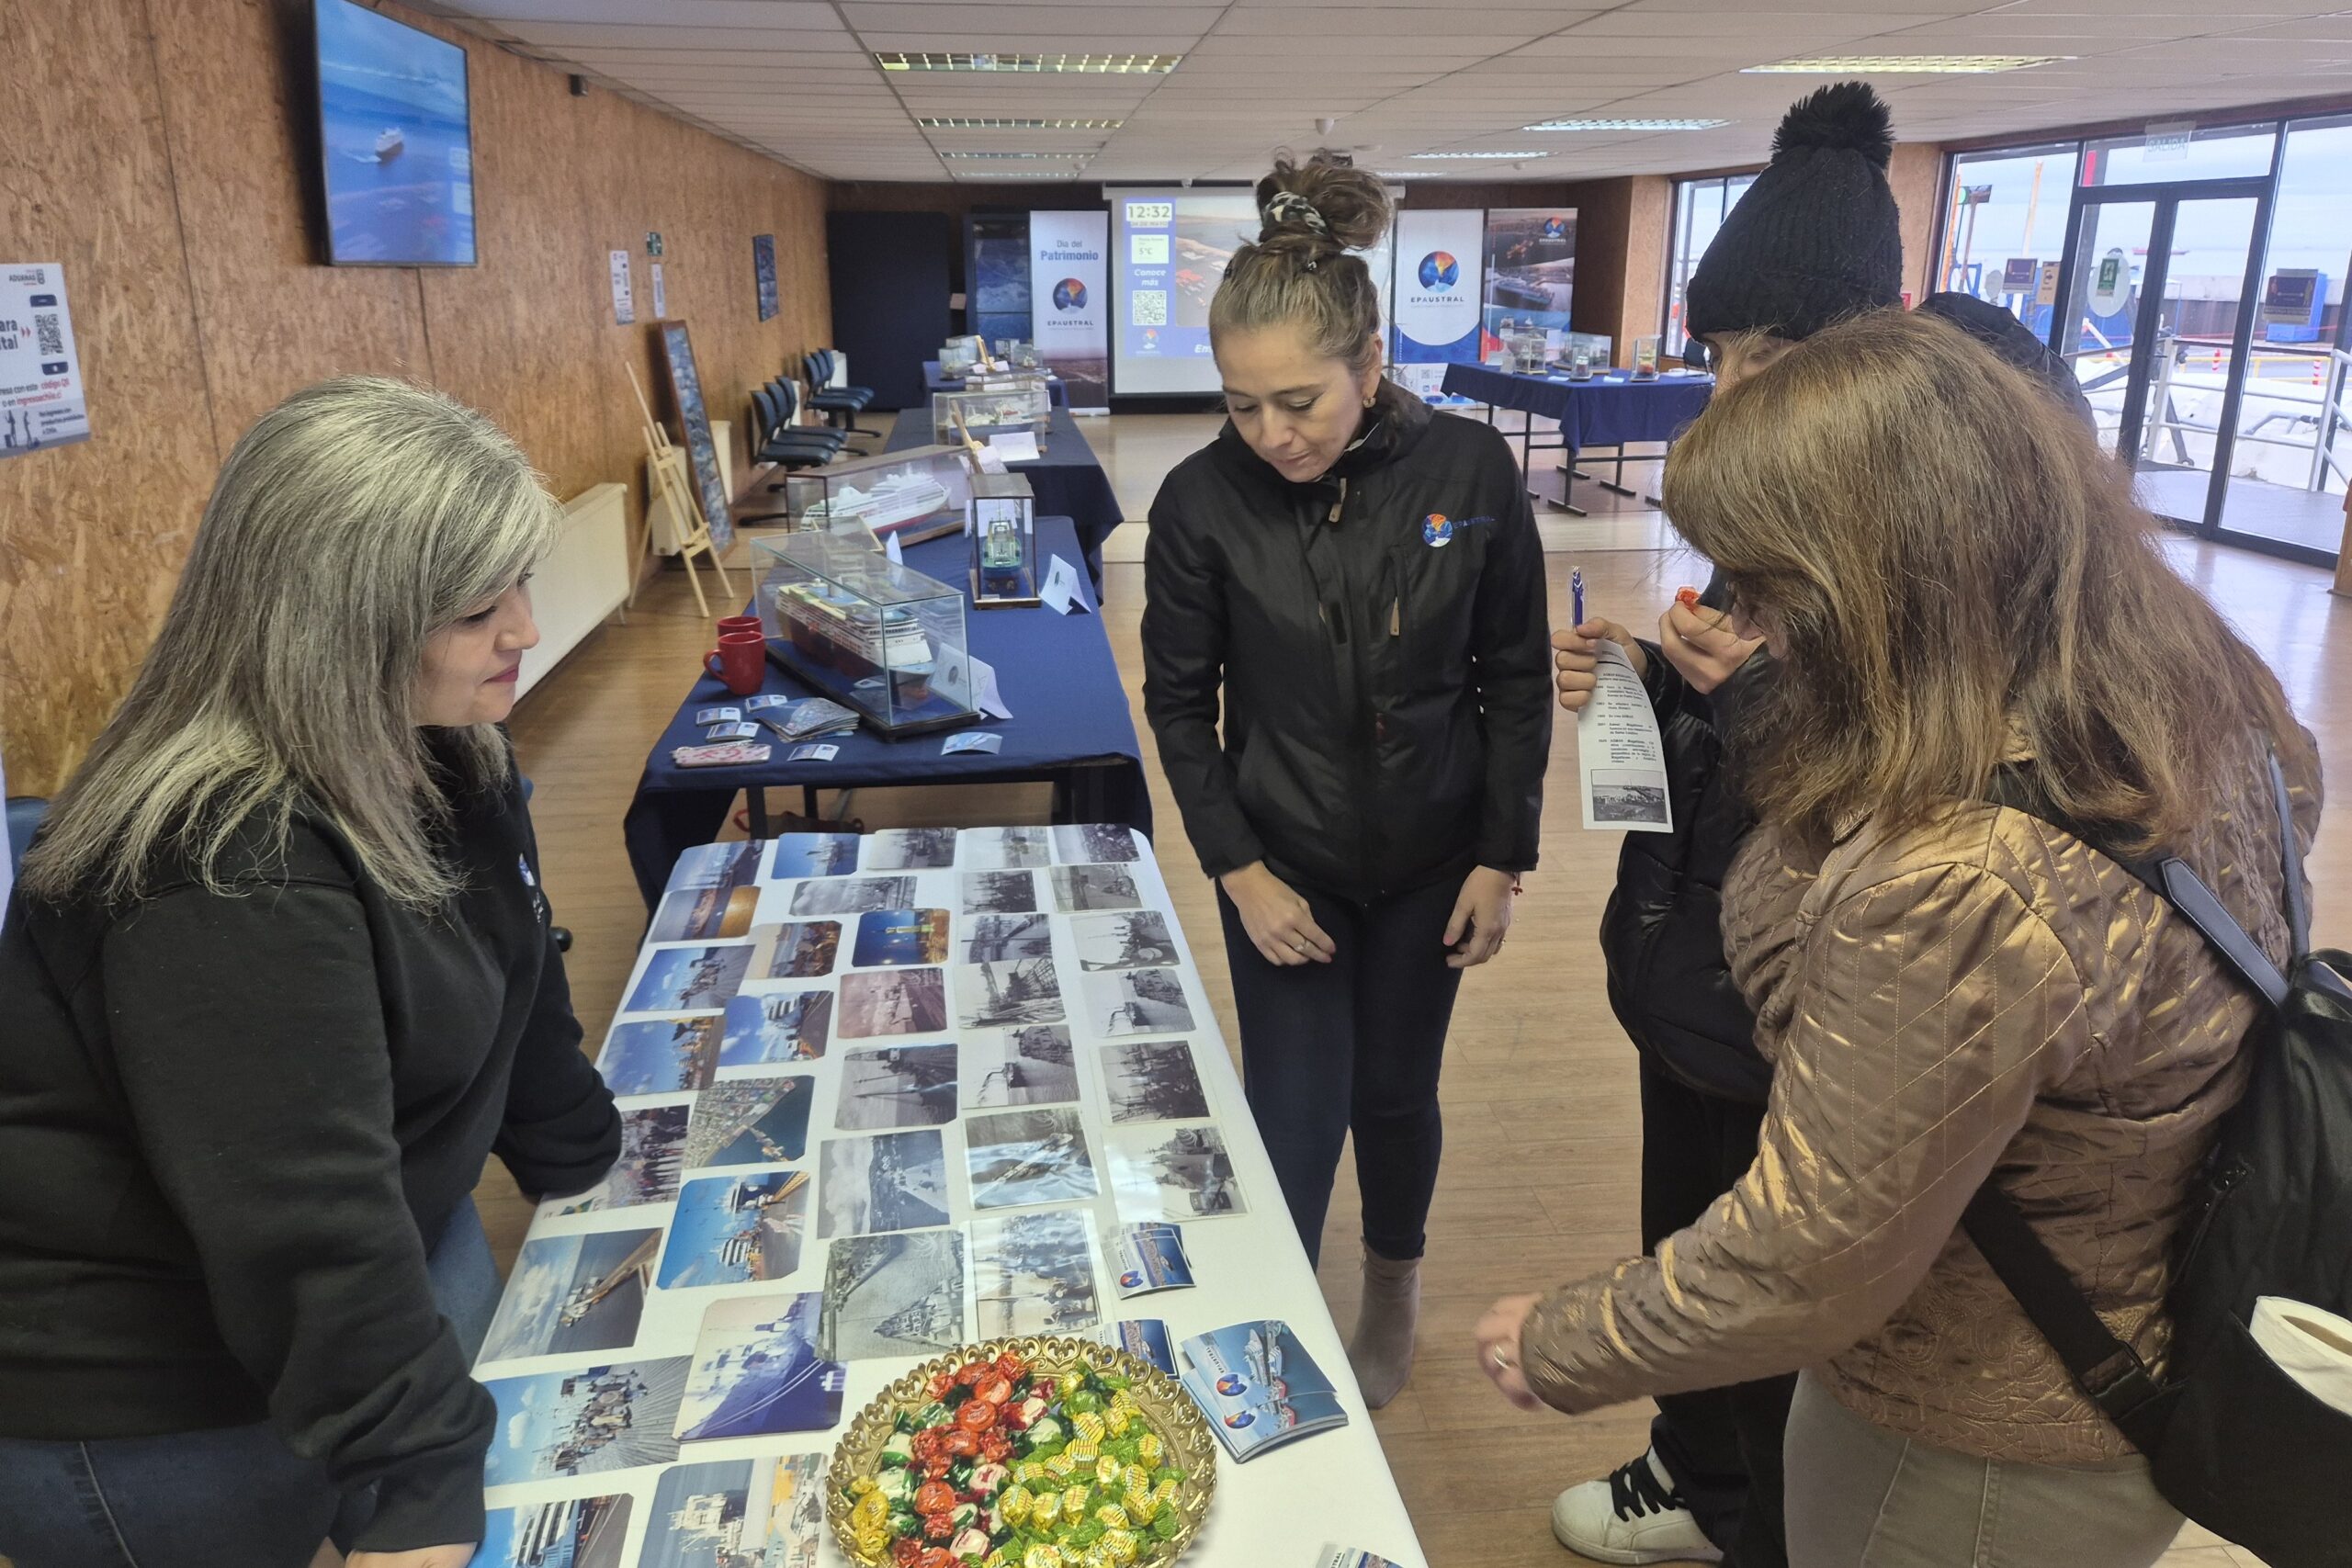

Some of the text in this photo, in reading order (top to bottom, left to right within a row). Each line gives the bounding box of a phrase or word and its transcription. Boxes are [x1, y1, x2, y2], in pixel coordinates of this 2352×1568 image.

[2148, 137, 2186, 152] SALIDA
[1128, 205, 1170, 219] 12:32
[1071, 240, 1082, 248] del
[1040, 250, 1099, 261] Patrimonio
[1134, 268, 1167, 277] Conoce
[0, 333, 18, 350] tal
[1194, 344, 1213, 354] Em
[1205, 1347, 1226, 1373] EPAUSTRAL
